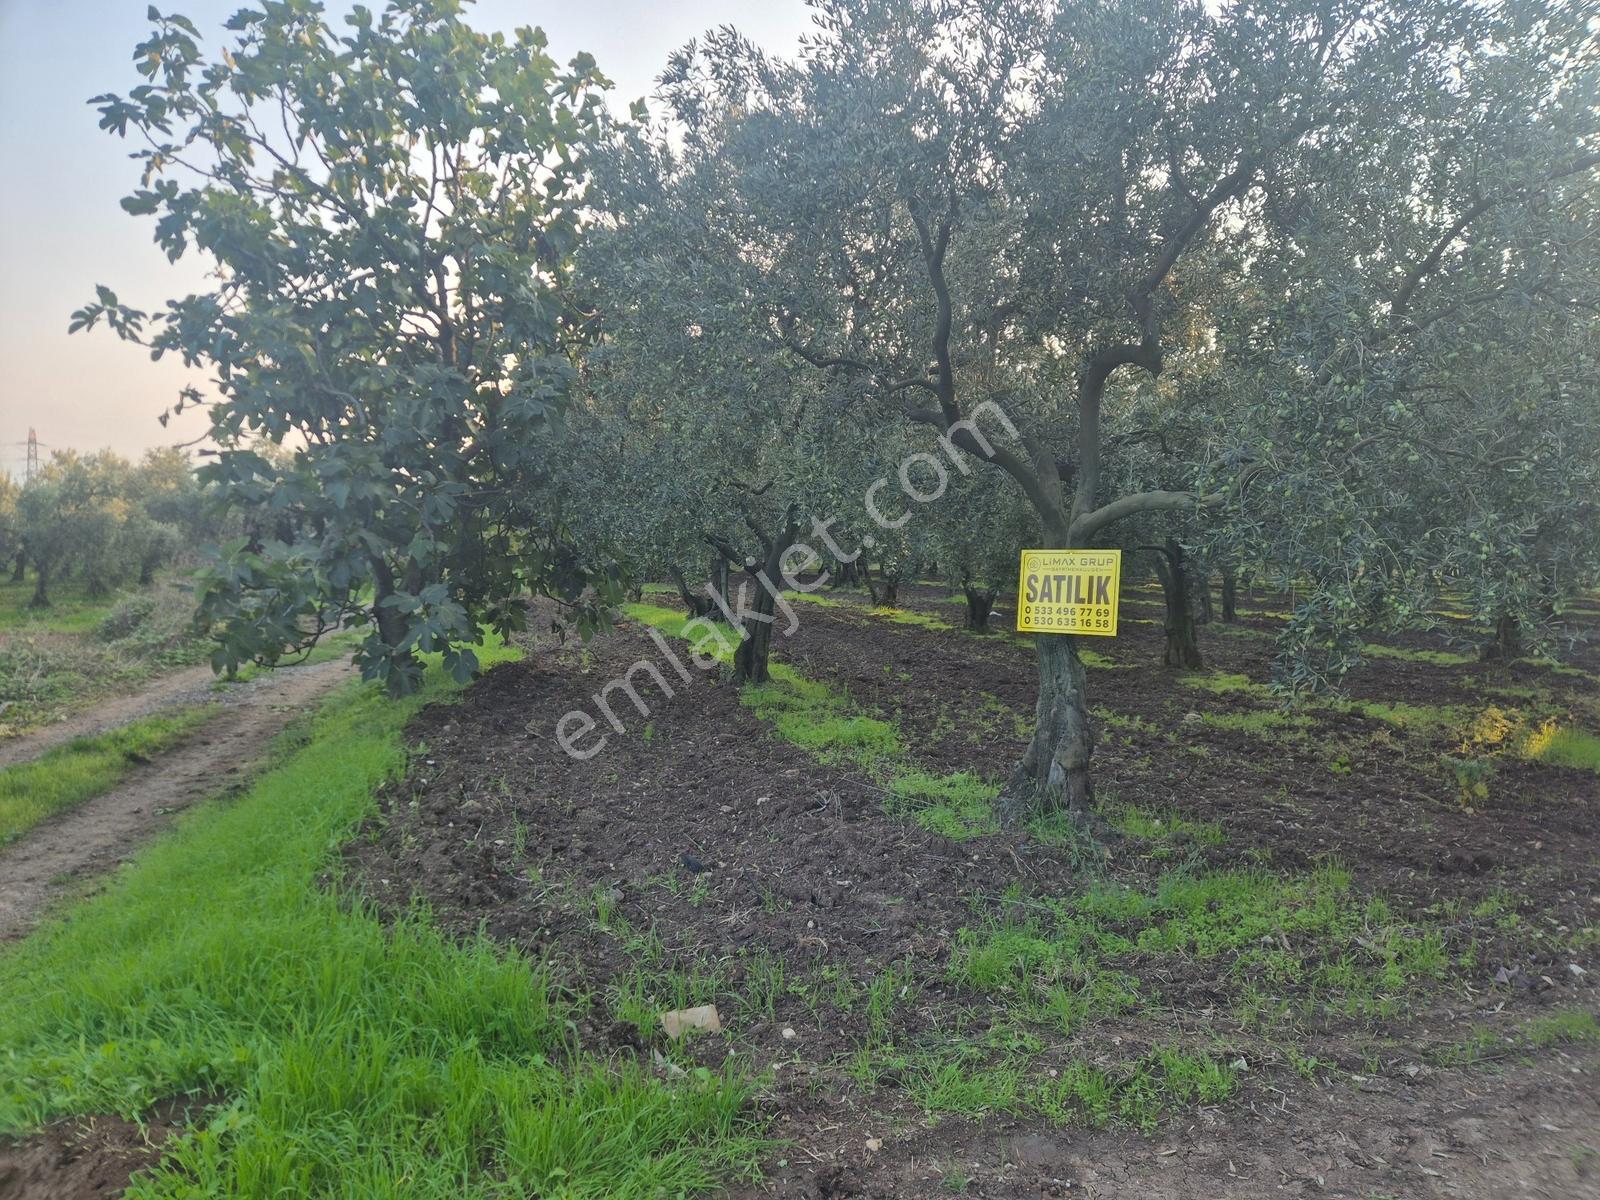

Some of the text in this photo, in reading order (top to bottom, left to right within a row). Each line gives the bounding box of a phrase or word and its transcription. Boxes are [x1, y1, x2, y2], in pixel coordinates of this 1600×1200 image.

[1080, 558, 1114, 567] GRUP
[1026, 574, 1111, 605] SATILIK
[1035, 606, 1053, 615] 533
[1056, 607, 1076, 616] 496
[1080, 608, 1092, 617] 77
[1096, 609, 1110, 618] 69
[1034, 617, 1053, 626] 530
[1057, 618, 1077, 627] 635
[1080, 619, 1092, 628] 16
[1096, 620, 1110, 629] 58
